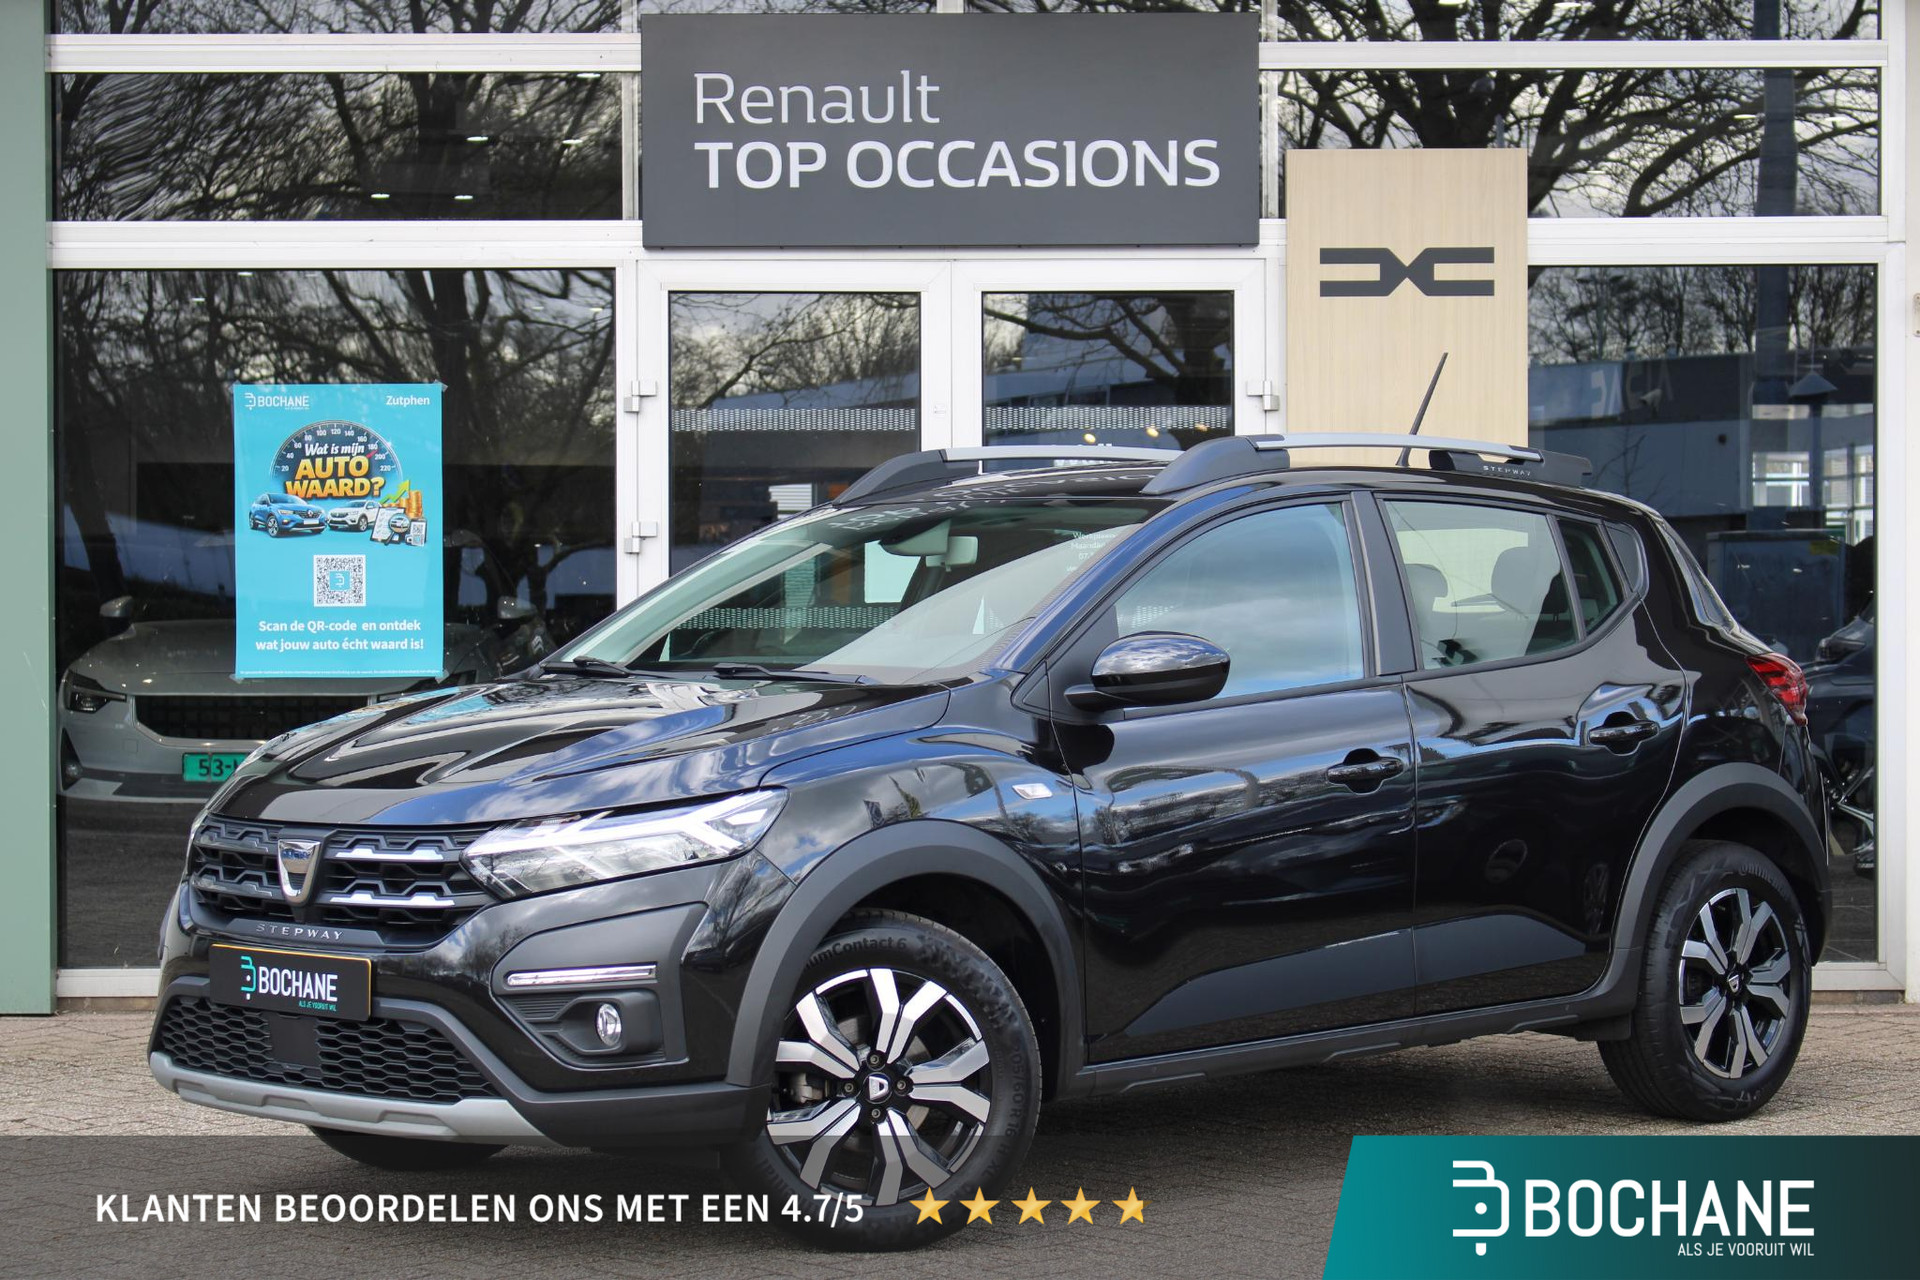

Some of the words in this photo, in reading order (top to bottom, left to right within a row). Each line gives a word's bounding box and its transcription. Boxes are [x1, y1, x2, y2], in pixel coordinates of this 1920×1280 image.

[694, 70, 940, 124] Renault
[694, 141, 827, 189] TOP
[847, 139, 1220, 188] OCCASIONS
[258, 395, 310, 407] BOCHANE
[386, 395, 430, 407] Zutphen
[344, 429, 355, 437] 140
[304, 443, 329, 457] Wat
[330, 444, 340, 455] is
[340, 443, 365, 457] mijn
[295, 455, 370, 480] AUTO
[1482, 465, 1531, 477] STEPWAY
[285, 476, 385, 499] WAARD?
[259, 620, 287, 632] Scan
[290, 619, 305, 632] de
[307, 620, 357, 633] QR-code
[361, 623, 377, 632] en
[379, 619, 421, 632] ontdek
[255, 640, 278, 650] wat
[279, 639, 310, 652] jouw
[312, 639, 339, 650] auto
[341, 637, 368, 650] écht
[370, 637, 408, 650] waard
[411, 637, 424, 650] is!
[256, 923, 344, 941] STEPWAY
[897, 937, 908, 950] 6
[258, 966, 339, 1002] BOCHANE
